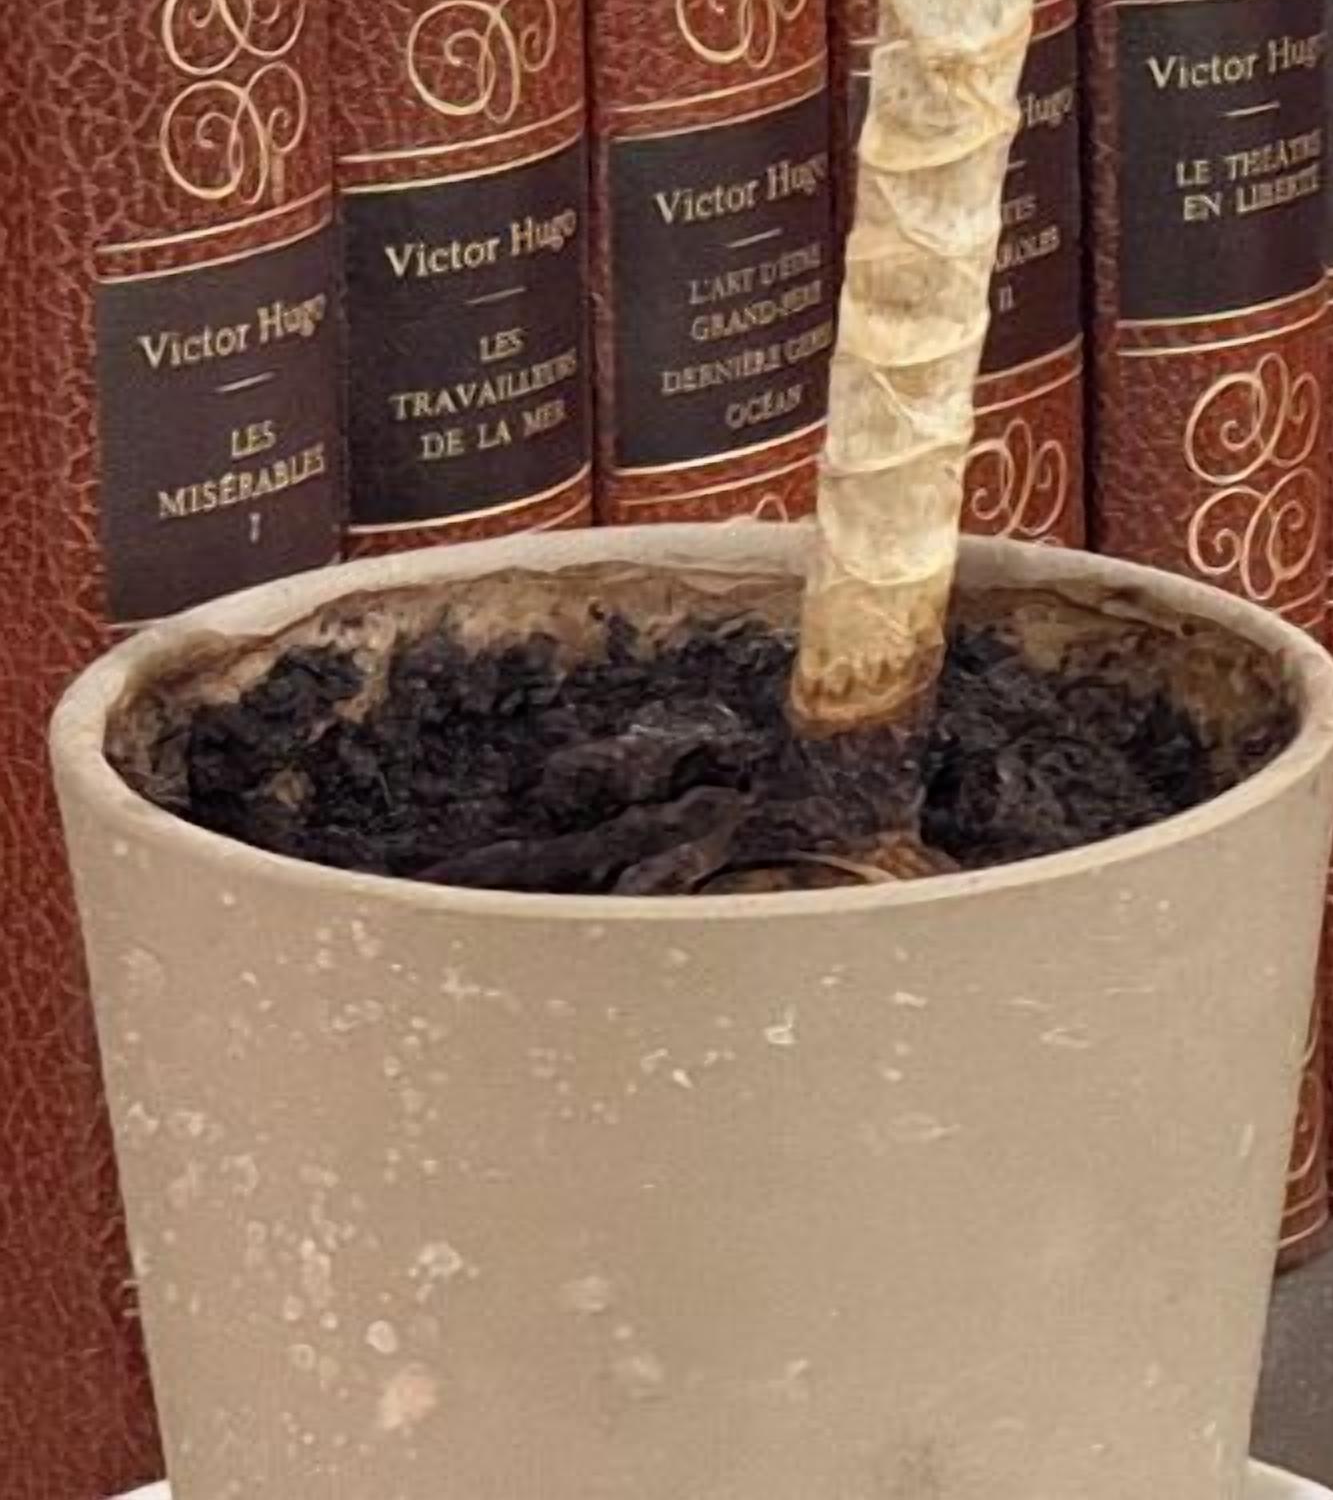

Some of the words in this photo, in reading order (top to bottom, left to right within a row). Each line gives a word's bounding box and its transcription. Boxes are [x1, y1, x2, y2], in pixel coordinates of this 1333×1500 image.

[1147, 53, 1260, 89] Victor
[1175, 160, 1212, 189] LE
[653, 179, 759, 224] Victor
[1183, 191, 1223, 221] EN
[384, 238, 500, 277] Victor
[510, 209, 576, 257] Hugo
[138, 324, 250, 368] Victor
[480, 328, 524, 363] LES
[231, 420, 276, 459] LES
[419, 428, 465, 462] DE
[476, 420, 513, 450] LA
[157, 441, 325, 518] MISÉRABLES
